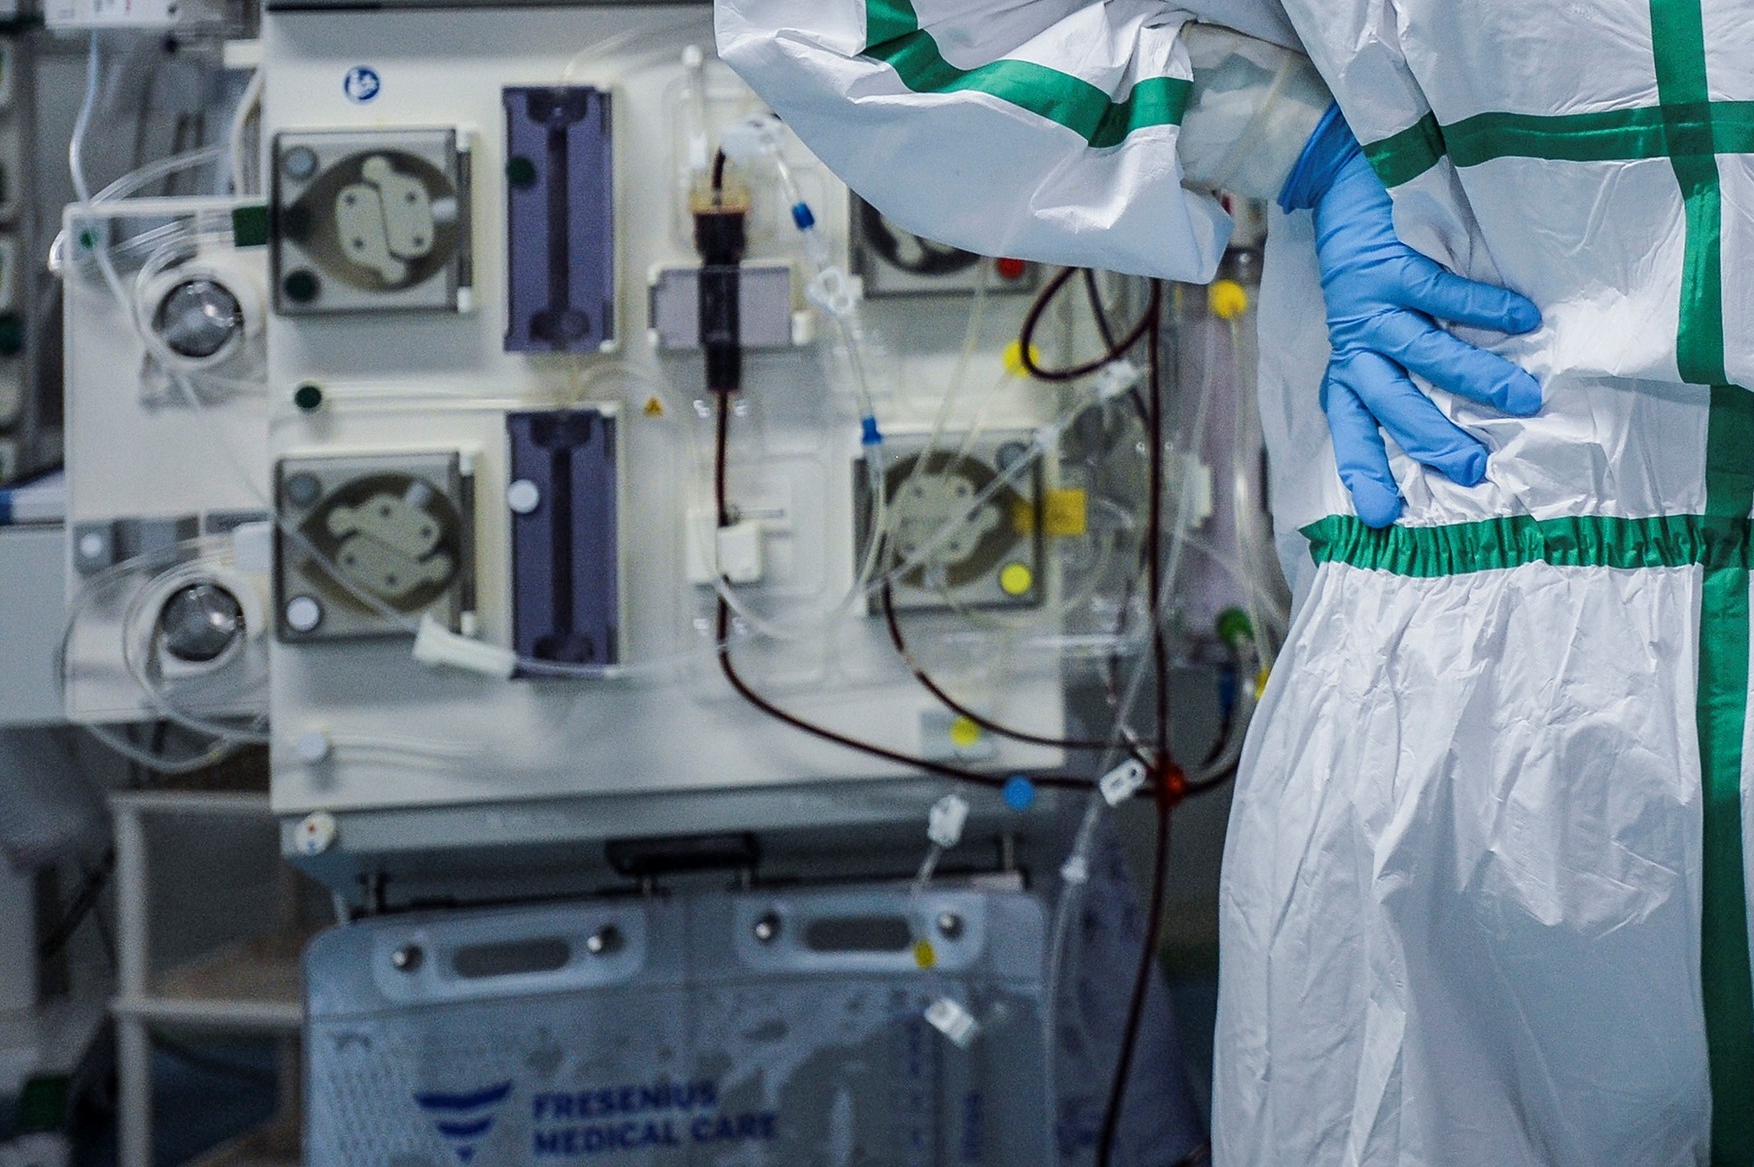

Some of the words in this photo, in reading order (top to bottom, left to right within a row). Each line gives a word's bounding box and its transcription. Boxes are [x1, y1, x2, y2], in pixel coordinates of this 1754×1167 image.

[533, 1079, 718, 1120] FRESENIUS
[533, 1121, 680, 1155] MEDICAL
[691, 1111, 778, 1143] CARE
